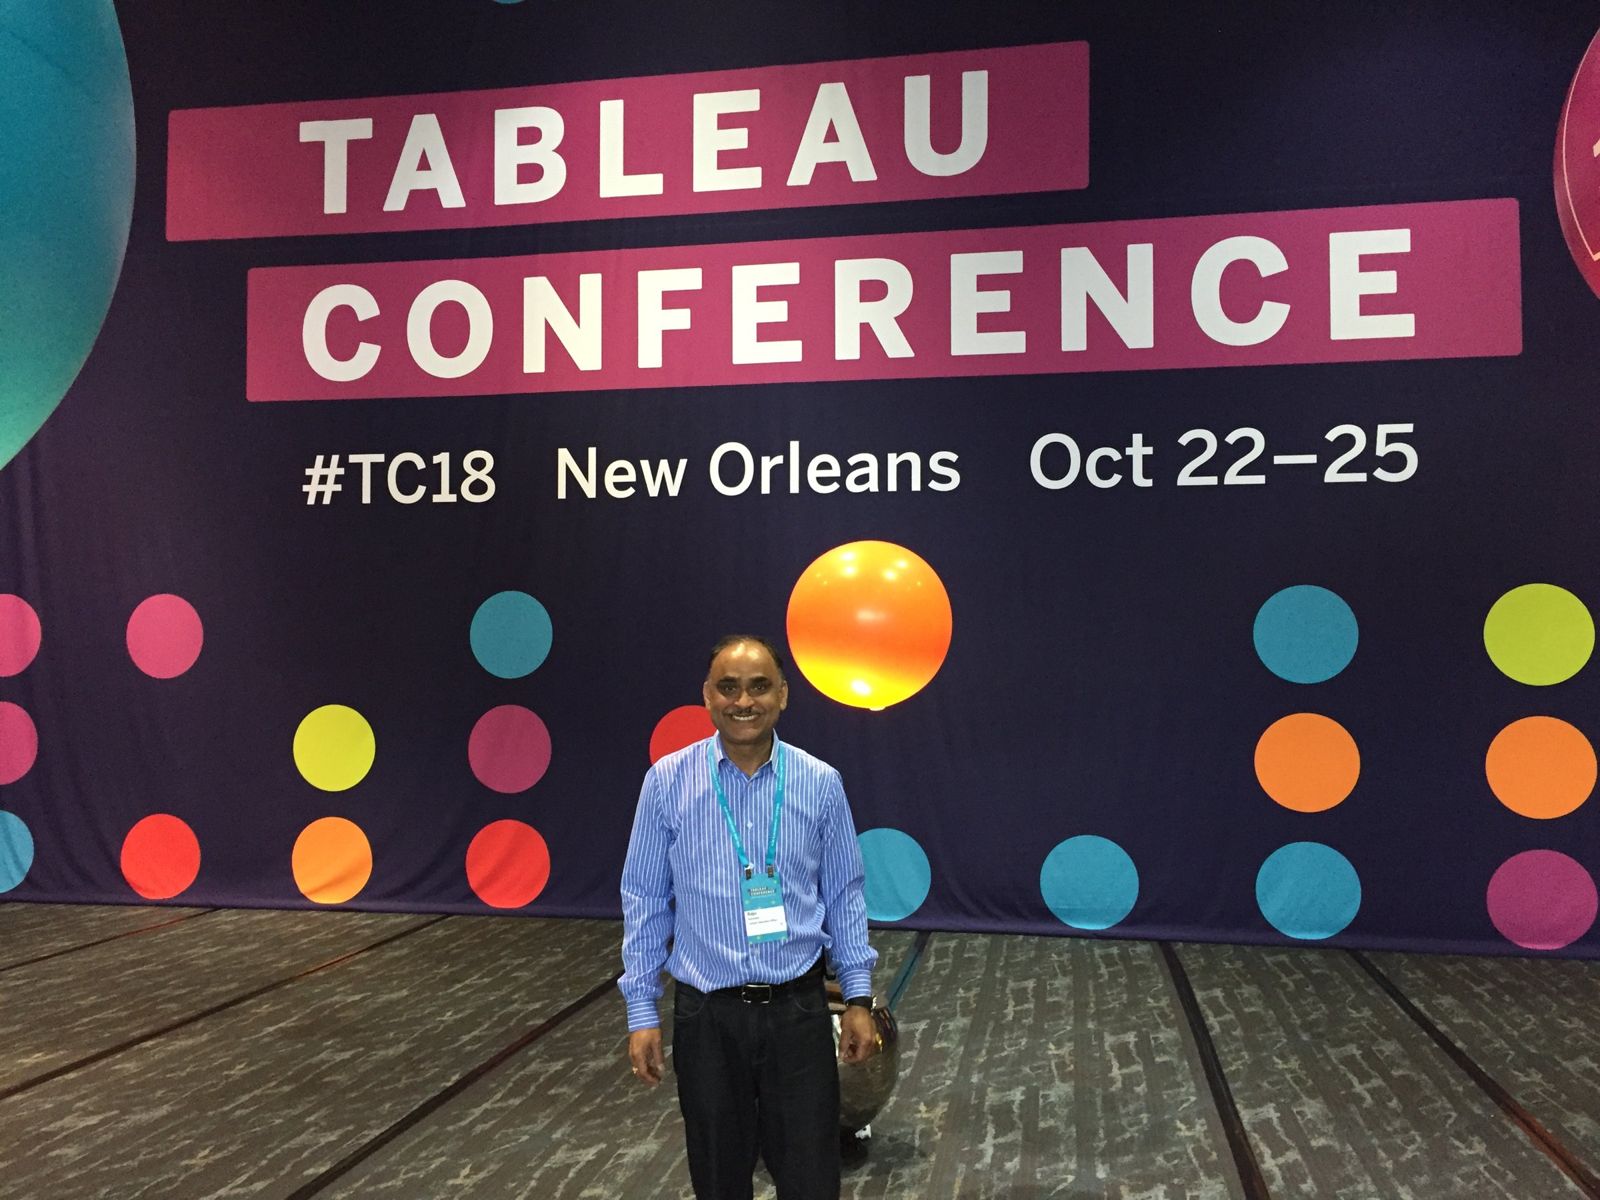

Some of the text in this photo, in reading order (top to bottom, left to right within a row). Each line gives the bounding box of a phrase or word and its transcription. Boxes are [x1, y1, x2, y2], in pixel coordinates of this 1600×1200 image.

[299, 70, 988, 214] TABLEAU
[302, 228, 1416, 382] CONFERENCE
[302, 450, 496, 505] #TC18
[557, 440, 961, 499] New Orleans
[1030, 423, 1419, 490] Oct 22–25
